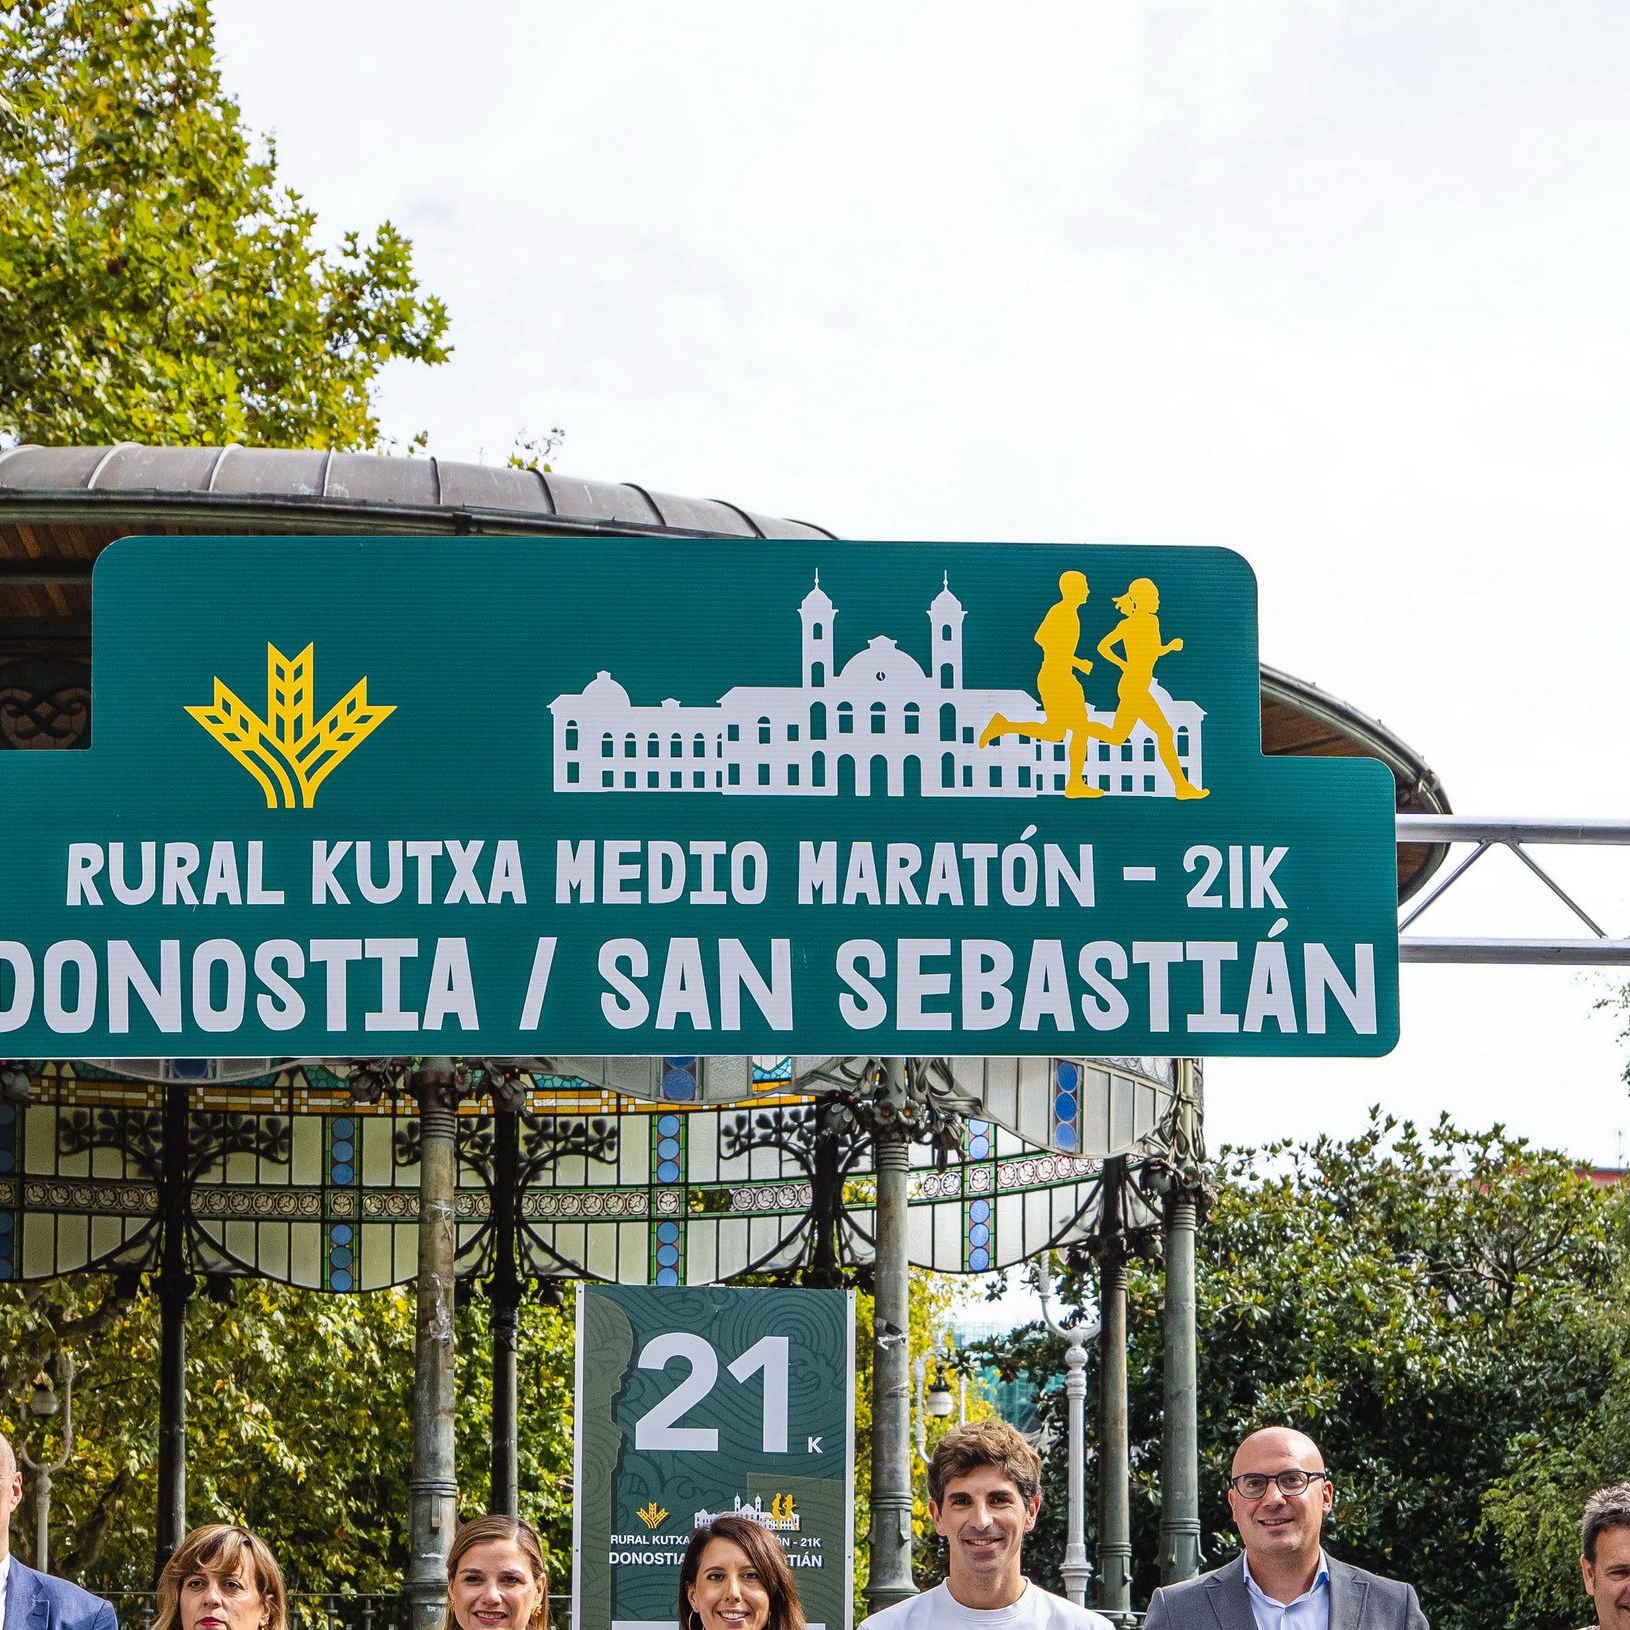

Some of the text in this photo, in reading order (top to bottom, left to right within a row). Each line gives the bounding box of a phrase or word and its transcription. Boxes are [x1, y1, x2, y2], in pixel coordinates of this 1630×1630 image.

[65, 840, 285, 907] RURAL
[310, 840, 527, 907] KUTXA
[555, 840, 769, 906] MEDIO
[797, 823, 1096, 907] MARATÓN
[1182, 843, 1290, 910] 21K
[519, 935, 558, 1031] /
[598, 935, 794, 1032] SAN
[836, 916, 1378, 1036] SEBASTIÁN
[634, 1332, 823, 1454] 21 K
[610, 1534, 650, 1545] RURAL
[652, 1535, 690, 1545] KUTXA
[800, 1537, 822, 1547] 21K
